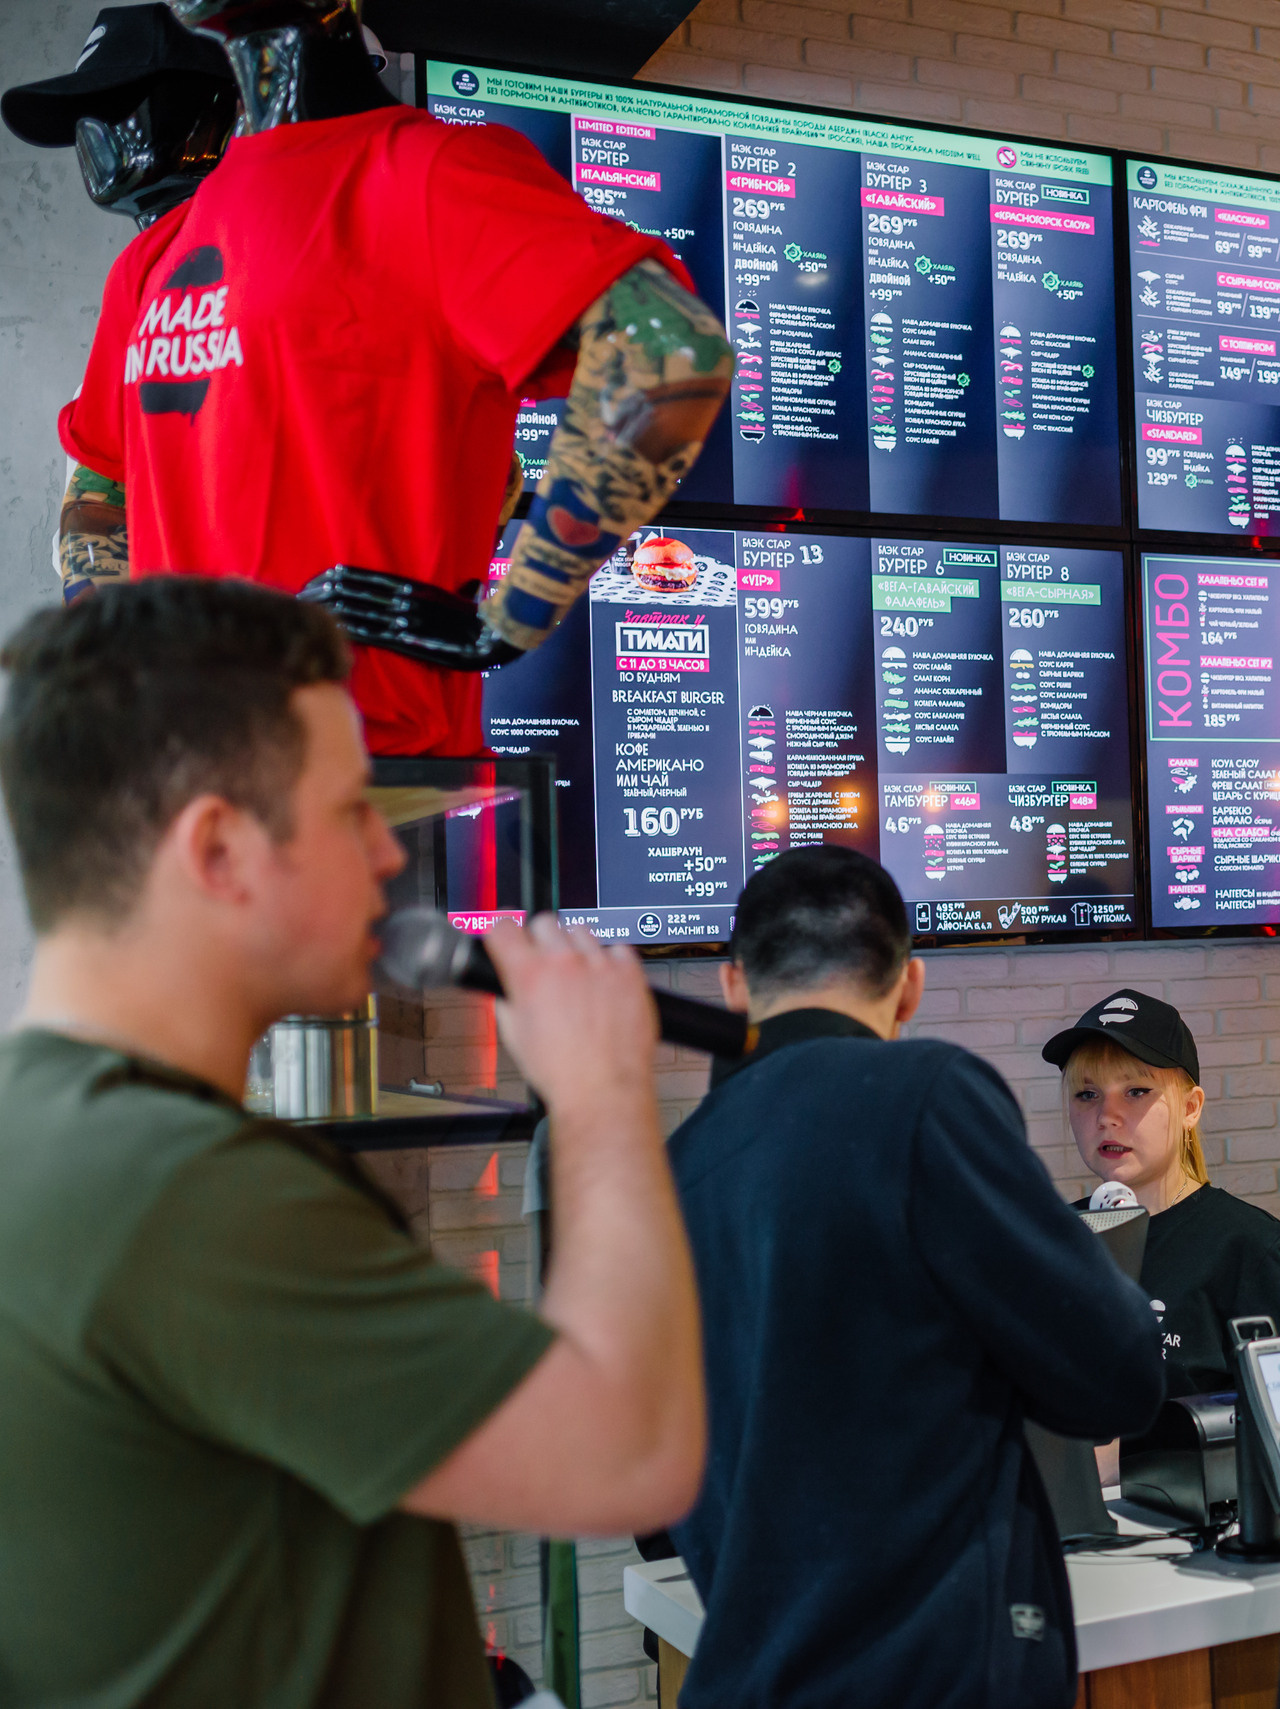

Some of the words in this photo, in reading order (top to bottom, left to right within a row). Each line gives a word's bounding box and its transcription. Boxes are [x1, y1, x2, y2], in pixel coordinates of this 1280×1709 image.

[486, 77, 502, 86] МЫ
[505, 79, 541, 92] ГОТОВИМ
[544, 85, 568, 96] НАШИ
[571, 89, 602, 100] БУРГЕРЫ
[615, 95, 634, 105] 100%
[636, 98, 693, 112] НАТУРАЛЬНОЙ
[696, 106, 749, 120] МРАМОРНОЙ
[434, 103, 457, 116] БЛЭК
[459, 108, 485, 117] СТАР
[578, 120, 613, 133] LIMITED
[616, 124, 651, 137] EDITION
[581, 137, 601, 149] БЛЭК
[603, 140, 626, 150] СТАР
[731, 143, 751, 154] БЛЭК
[753, 146, 776, 156] СТАР
[581, 149, 630, 166] БУРГЕР
[731, 155, 779, 174] БУРГЕР
[787, 162, 797, 177] 2
[581, 168, 656, 188] ИТАЛЬЯНСКИЙ
[730, 176, 791, 192] «ГРИБНОЙ»
[866, 173, 912, 191] БУРГЕР
[919, 180, 928, 193] 3
[865, 192, 936, 211] «ГАВАЙСКИЙ»
[996, 190, 1039, 206] БУРГЕР
[1133, 197, 1189, 217] КАРТОФЕЛЬ
[1190, 203, 1207, 218] ФРИ
[994, 210, 1061, 228] «КРАСНОГОРСК
[1064, 219, 1091, 231] СЛОУ»
[733, 221, 783, 235] ГОВЯДИНА
[733, 241, 776, 255] ИНДЕЙКА
[868, 236, 915, 250] ГОВЯДИНА
[734, 258, 778, 272] ДВОЙНОЙ
[868, 256, 909, 270] ИНДЕЙКА
[998, 252, 1042, 265] ГОВЯДИНА
[869, 273, 911, 286] ДВОЙНОЙ
[998, 270, 1036, 284] ИНДЕЙКА
[138, 285, 229, 337] MADE
[124, 337, 147, 385] IN
[145, 326, 243, 377] RUSSIA
[1146, 409, 1204, 425] ЧИЗБУРГЕР
[742, 538, 764, 548] БЛЭК
[766, 539, 791, 549] СТАР
[878, 545, 899, 556] БЛЭК
[901, 547, 924, 556] СТАР
[743, 551, 795, 568] БУРГЕР
[799, 545, 824, 565] 13
[949, 553, 991, 564] НОВИНКА
[1006, 552, 1026, 562] БЛЭК
[1028, 553, 1050, 563] СТАР
[878, 557, 928, 575] БУРГЕР
[935, 561, 945, 576] 6
[1006, 564, 1053, 581] БУРГЕР
[1060, 566, 1070, 581] 8
[741, 574, 774, 587] «VIP»
[878, 581, 975, 596] «ВЕГА-ГАВАЙСКИЙ
[1006, 587, 1095, 601] «ВЕГА-СЫРНАЯ»
[744, 597, 785, 619] 599
[885, 596, 946, 609] ФАЛАФЕЛЬ»
[622, 609, 690, 629] Завтрак
[692, 614, 706, 629] у
[1008, 608, 1045, 628] 260
[744, 623, 799, 635] ГОВЯДИНА
[880, 616, 919, 637] 240
[622, 629, 703, 651] ТИМАТИ
[744, 644, 792, 658] ИНДЕЙКА
[1154, 573, 1192, 727] КОМБО
[619, 659, 627, 669] С
[630, 659, 637, 670] 11
[639, 659, 656, 672] ДО
[659, 660, 667, 671] 13
[669, 660, 705, 671] ЧАСОВ
[619, 672, 635, 683] ПО
[636, 673, 681, 684] БУДНЯМ
[612, 690, 677, 703] BREAKFAST
[680, 691, 725, 704] BURGER
[615, 743, 649, 756] КОФЕ
[615, 759, 704, 771] АМЕРИКАНО
[1211, 759, 1234, 768] КОУЛ
[1235, 759, 1259, 768] СЛОУ
[616, 774, 638, 787] ИЛИ
[641, 771, 669, 787] ЧАЙ
[884, 795, 949, 808] ГАМБУРГЕР
[954, 797, 977, 806] «46»
[1008, 794, 1069, 808] ЧИЗБУРГЕР
[1071, 796, 1094, 806] «48»
[1212, 806, 1252, 815] БАРБЕКЮ
[623, 807, 680, 837] 160
[680, 808, 704, 820] РУБ
[648, 846, 702, 857] ХАШБРАУН
[683, 857, 715, 871] +50
[648, 872, 694, 882] КОТЛЕТА
[684, 882, 715, 897] +99
[668, 914, 686, 924] 222
[936, 911, 963, 921] ЧЕХОЛ
[964, 911, 981, 921] ДЛЯ
[1021, 915, 1041, 924] ТАТУ
[1041, 915, 1067, 924] РУКАВ
[1093, 913, 1131, 923] ФУТБОЛКА
[668, 925, 704, 936] МАГНИТ
[706, 925, 720, 935] BSB
